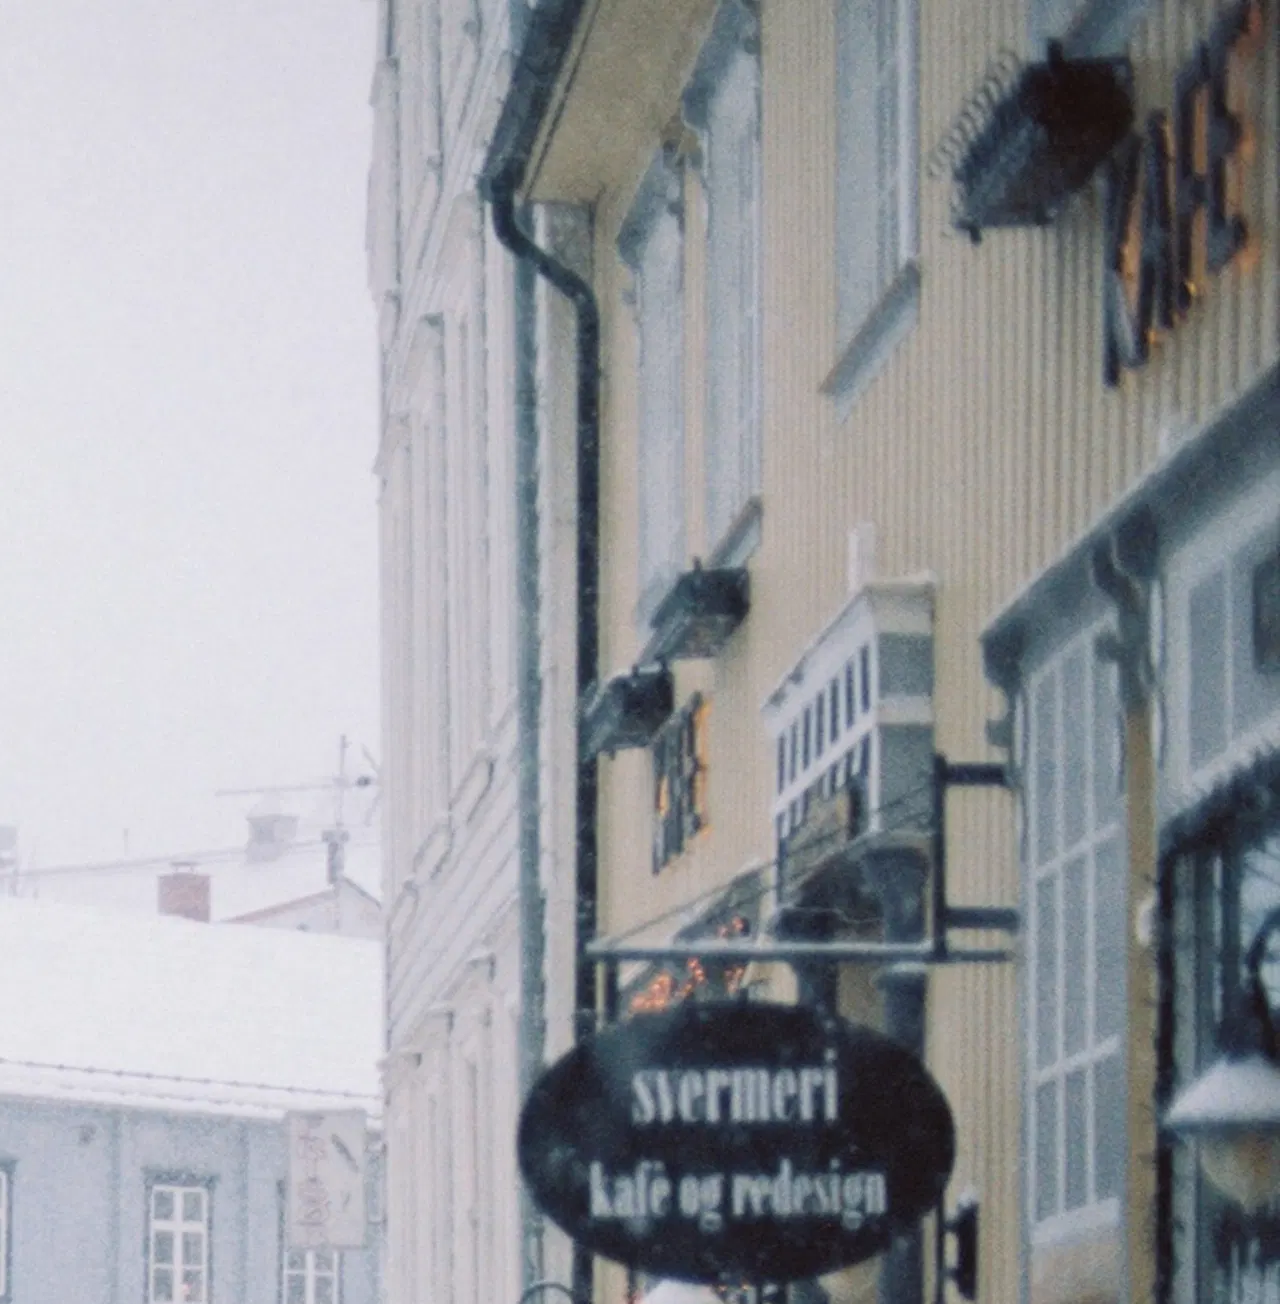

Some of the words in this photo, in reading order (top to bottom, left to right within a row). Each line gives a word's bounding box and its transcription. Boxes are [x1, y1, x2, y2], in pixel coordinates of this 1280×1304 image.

[631, 1048, 838, 1125] svermeri
[679, 1171, 725, 1232] og
[731, 1157, 887, 1231] redesign
